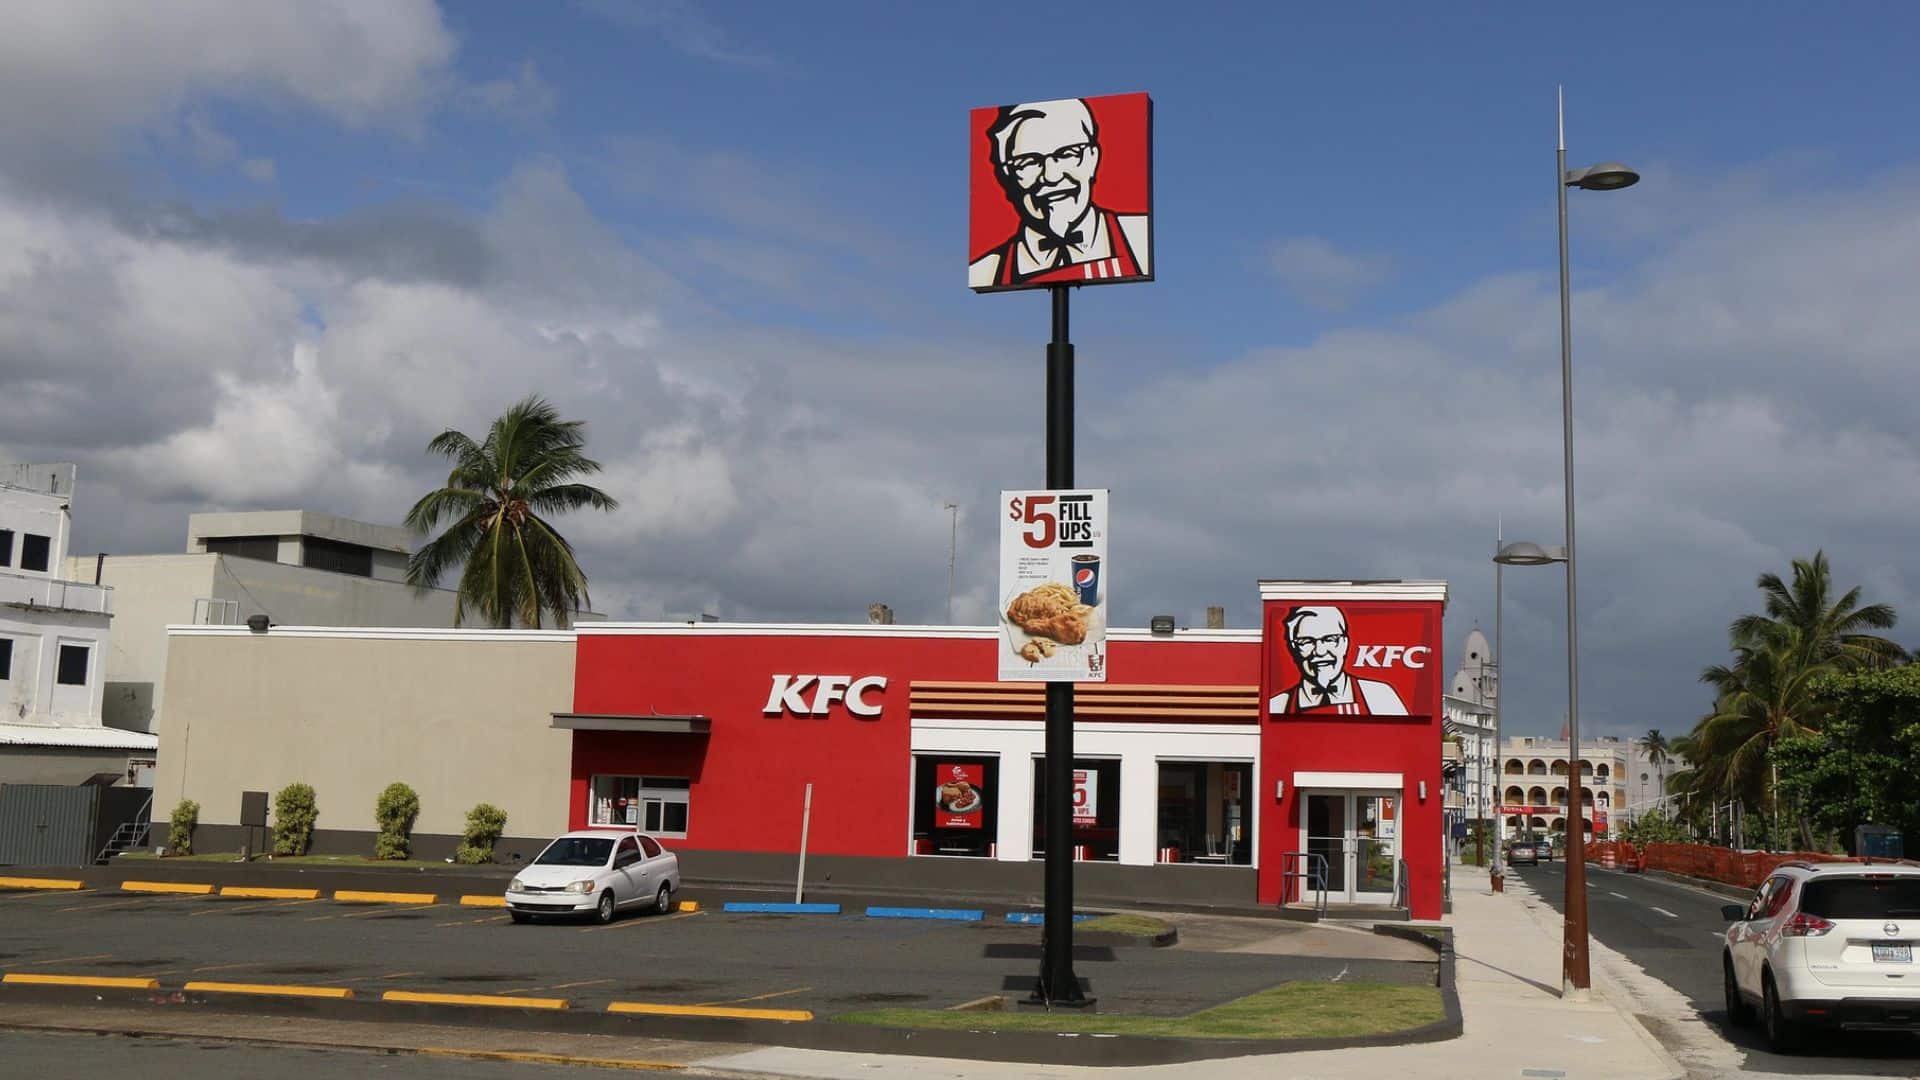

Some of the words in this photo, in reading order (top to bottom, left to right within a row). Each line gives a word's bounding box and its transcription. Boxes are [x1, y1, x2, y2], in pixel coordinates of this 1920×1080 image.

[1009, 496, 1056, 549] $5
[1059, 503, 1092, 520] FILL
[1059, 522, 1091, 540] UPS
[1352, 645, 1425, 668] KFC
[762, 674, 887, 716] KFC
